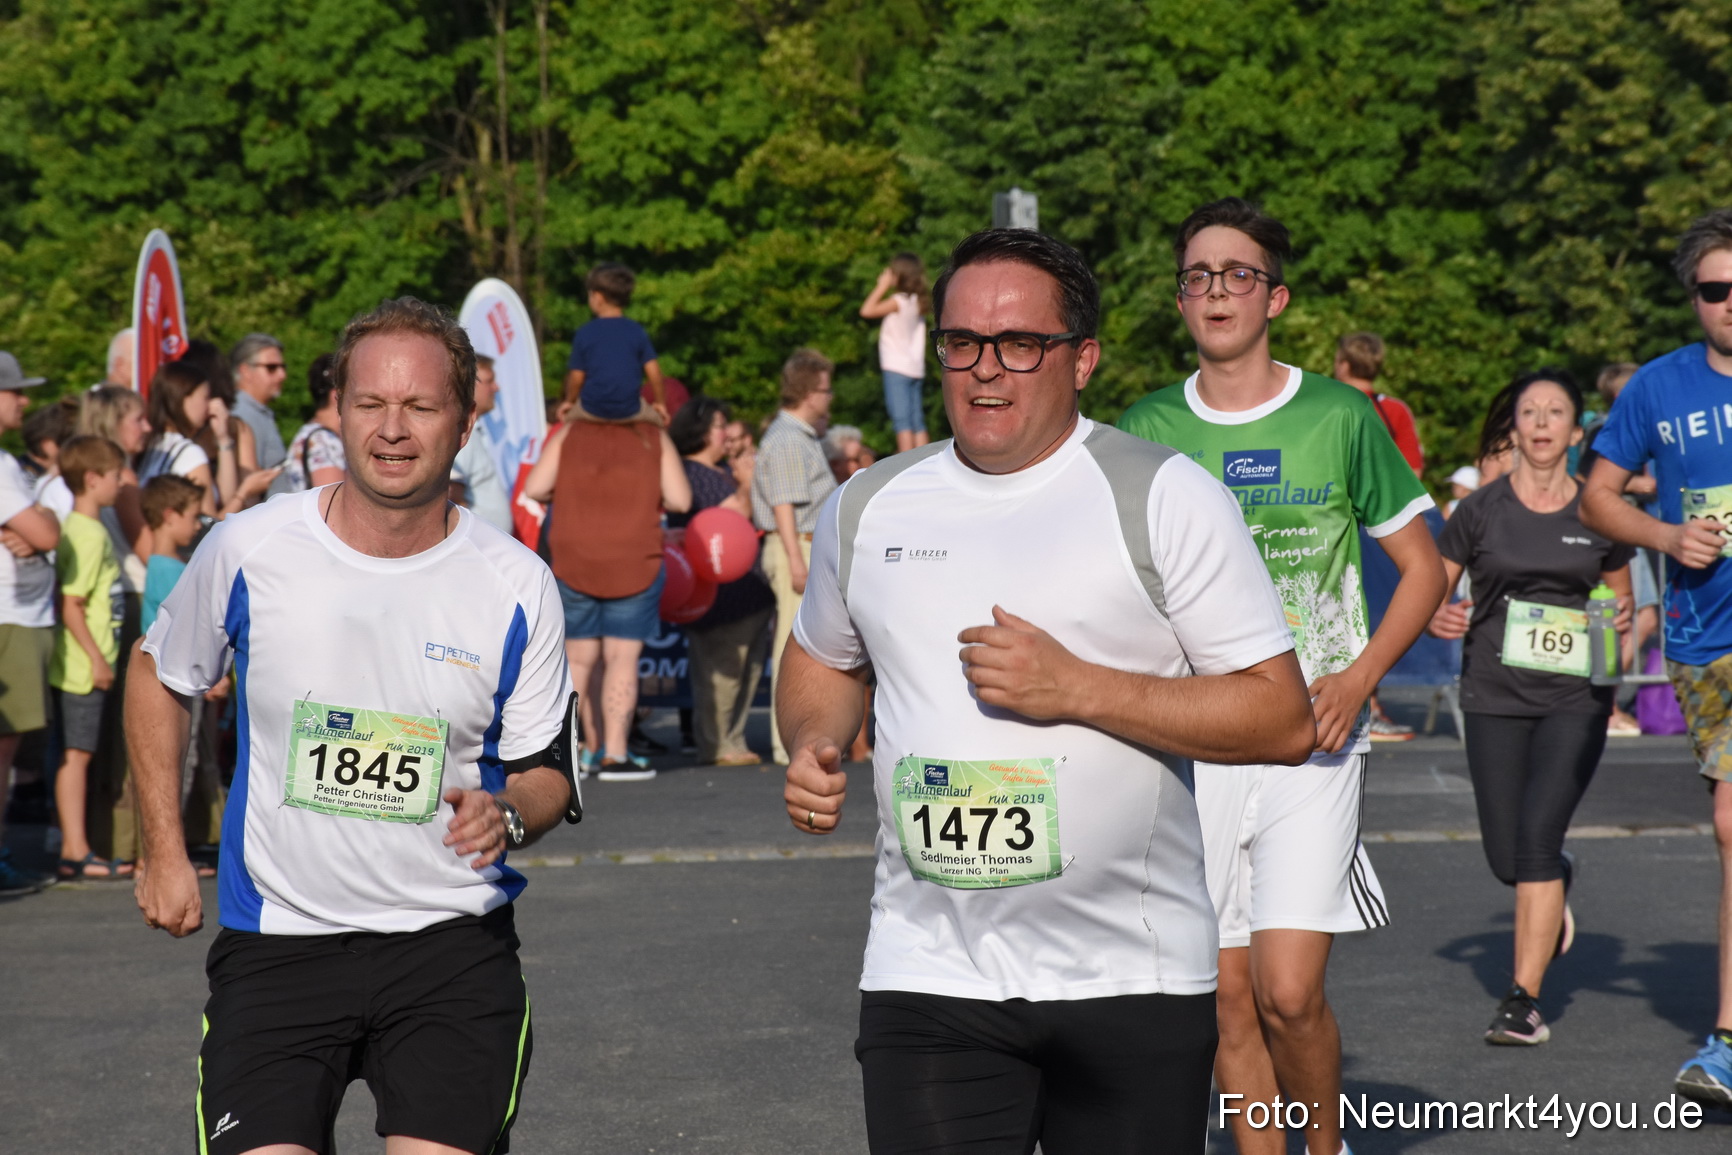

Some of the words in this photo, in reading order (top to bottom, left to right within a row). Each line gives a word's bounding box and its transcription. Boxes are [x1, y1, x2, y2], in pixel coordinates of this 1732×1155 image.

[1236, 463, 1278, 474] Fischer
[1249, 524, 1318, 539] Firmen
[909, 549, 948, 557] LERZER
[1265, 538, 1328, 566] länger!
[1527, 628, 1573, 654] 169
[446, 646, 481, 665] PETTER
[314, 723, 375, 741] firmenlauf
[407, 745, 435, 756] 2019
[309, 743, 421, 793] 1845
[316, 783, 350, 797] Petter
[353, 789, 404, 804] Christian
[914, 782, 973, 797] firmenlauf
[313, 794, 336, 804] Petter
[337, 798, 378, 811] Ingenieure
[380, 803, 404, 812] GmbH
[1013, 793, 1045, 805] 2019
[913, 804, 1034, 851] 1473
[920, 851, 976, 865] Sedlmeier
[980, 854, 1033, 865] Thomas
[940, 866, 964, 875] Lerzer
[966, 867, 982, 875] ING
[989, 867, 1009, 875] Plan
